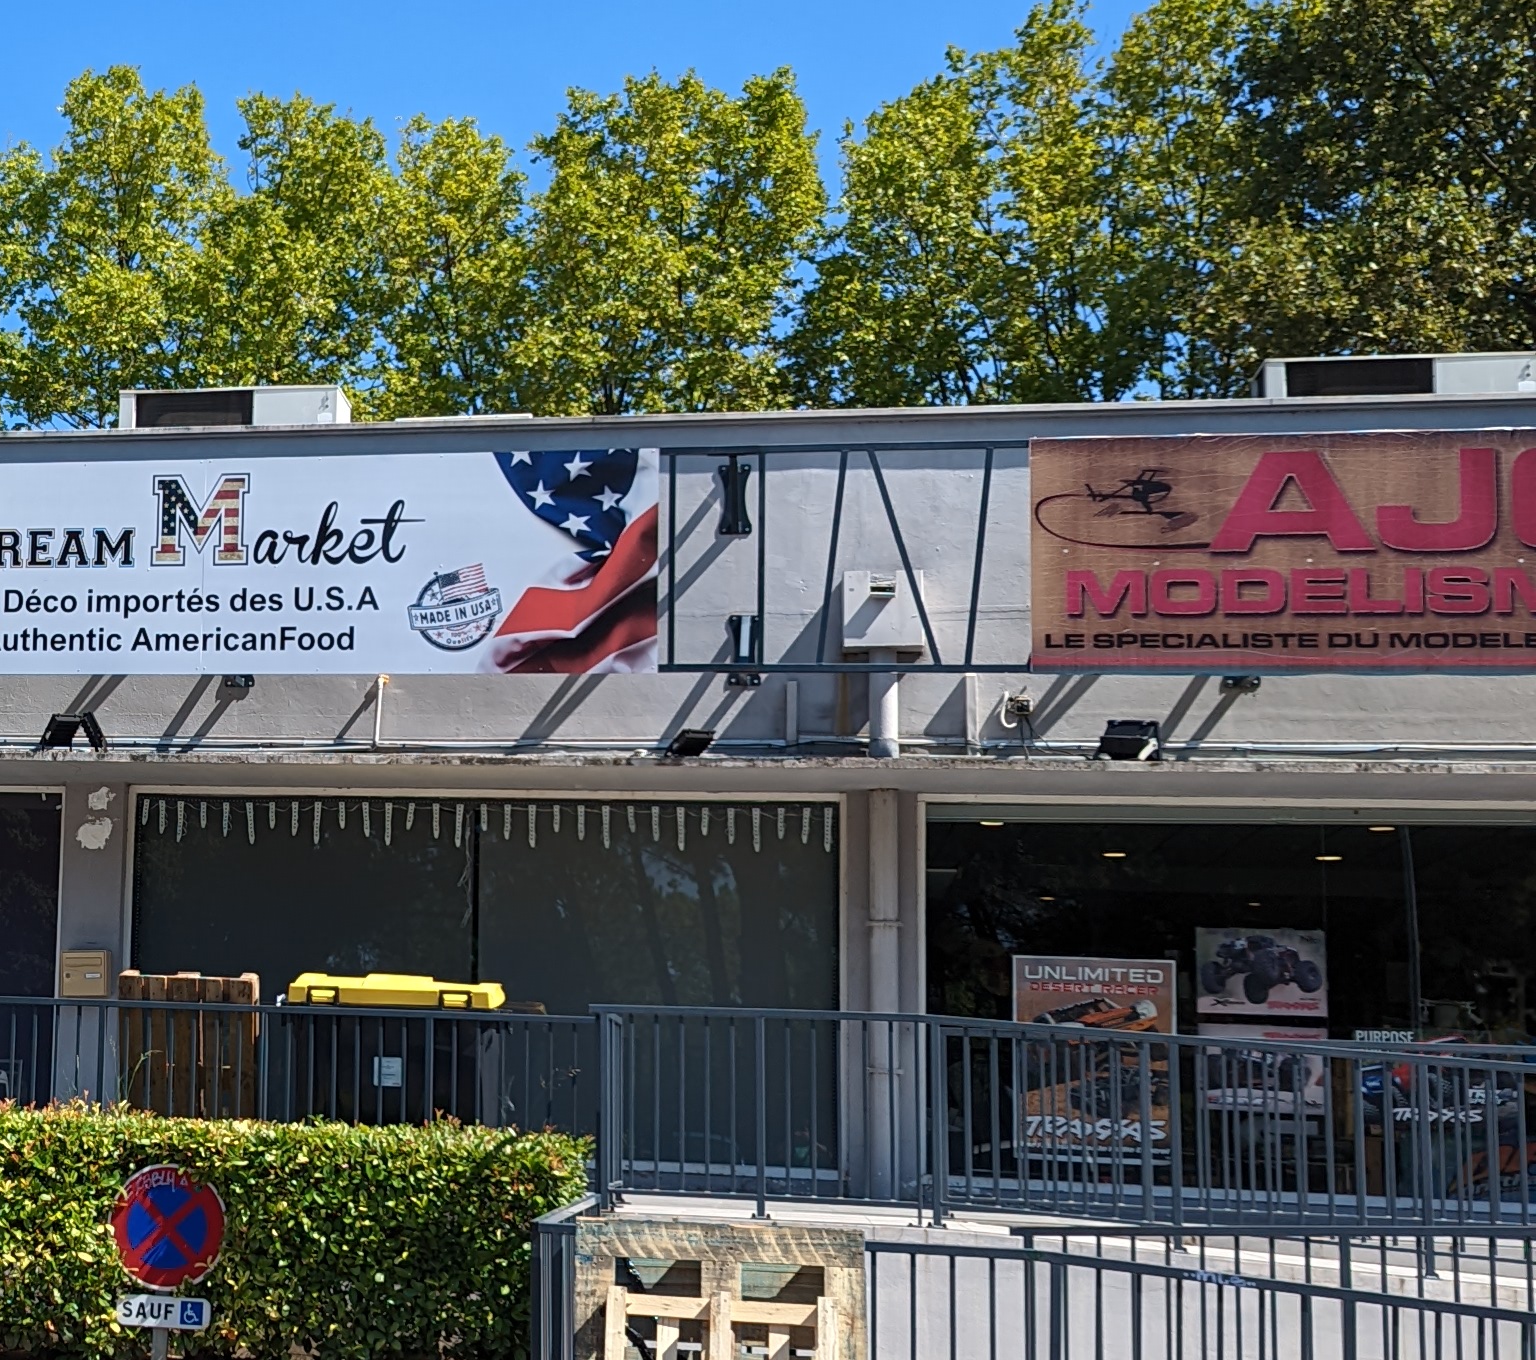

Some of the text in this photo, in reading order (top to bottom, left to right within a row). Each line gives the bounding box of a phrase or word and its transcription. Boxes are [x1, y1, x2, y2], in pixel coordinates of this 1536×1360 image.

[1210, 447, 1536, 552] AJ
[150, 473, 426, 566] Market
[3, 588, 78, 614] Déco
[87, 588, 220, 619] importés
[229, 588, 283, 613] des
[294, 586, 380, 612] U.S.A
[420, 599, 492, 625] MADE IN USA
[131, 626, 355, 652] AmericanFood
[1045, 634, 1086, 649] LE
[1093, 632, 1319, 649] SPECIALISTE
[1328, 633, 1379, 649] DU
[1025, 965, 1164, 984] UNLIMITED
[1030, 982, 1160, 996] DESERT RACER
[1355, 1029, 1415, 1044] PURPOSE
[122, 1300, 175, 1321] SAUF
